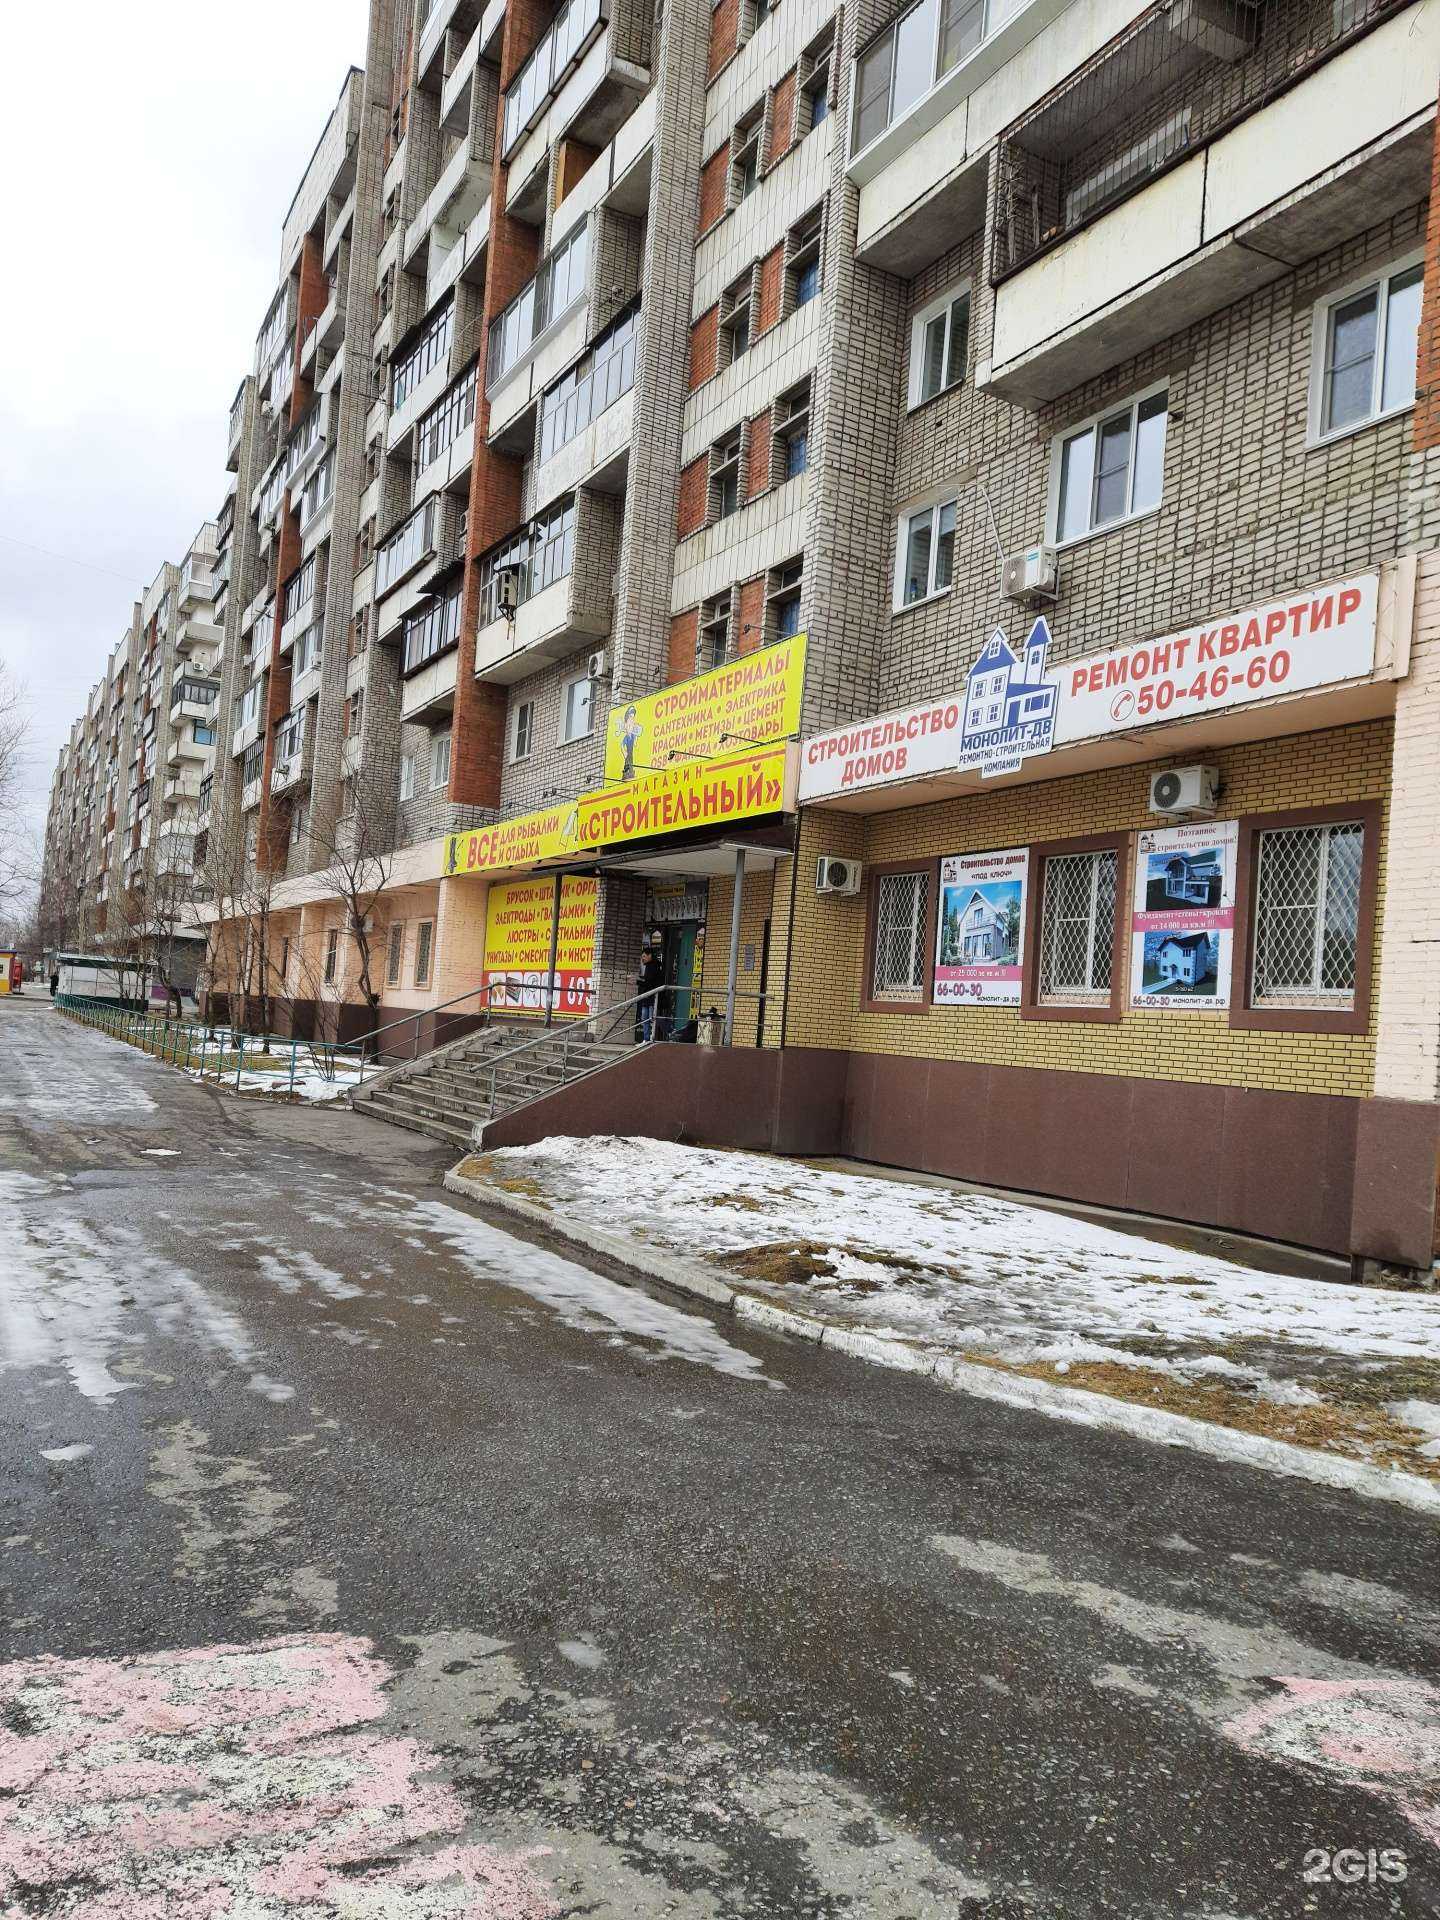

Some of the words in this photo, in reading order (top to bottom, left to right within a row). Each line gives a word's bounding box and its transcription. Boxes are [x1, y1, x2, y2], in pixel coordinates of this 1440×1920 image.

[1070, 637, 1191, 696] РЕМОНТ
[1197, 588, 1362, 663] КВАРТИР
[654, 650, 791, 719] СТРОЙМАТЕРИАЛЫ
[1137, 650, 1291, 715] 50-46-60
[653, 707, 713, 738] САНТЕХНИКА
[725, 679, 786, 713] ЭЛЕКТРИКА
[651, 732, 688, 755] КРАСКИ
[695, 713, 736, 741] МЕТИЗЫ
[743, 698, 786, 724] ЦЕМЕНТ
[808, 703, 959, 765] СТРОИТЕЛЬСТВО
[959, 737, 1051, 765] РЕМОНТНО-СТРОИТЕЛЬНАЯ
[984, 757, 1020, 774] КОМПАНИЯ
[632, 766, 702, 795] МАГАЗИН
[840, 746, 908, 787] ДОМОВ
[579, 764, 781, 842] «СТРОИТЕЛЬНЫЙ»
[500, 829, 515, 846] ДЛЯ
[517, 816, 560, 841] РЫБАЛКИ
[467, 826, 500, 869] ВСЁ
[498, 848, 505, 863] И
[506, 840, 540, 861] ОТДЫХА
[960, 857, 1004, 869] Строительство
[1005, 854, 1025, 865] домов
[506, 887, 534, 905] БРУСОК
[539, 883, 570, 901] ШТАИК
[495, 907, 536, 926] ЭЛЕКТРОДЫ
[507, 929, 540, 943] ЛЮСТРЫ
[545, 925, 595, 941] СТИЛЬНИ
[487, 950, 514, 964] УНИТАЗЫ
[519, 948, 563, 963] СМЕСИТИ
[937, 982, 982, 997] 66-00-30
